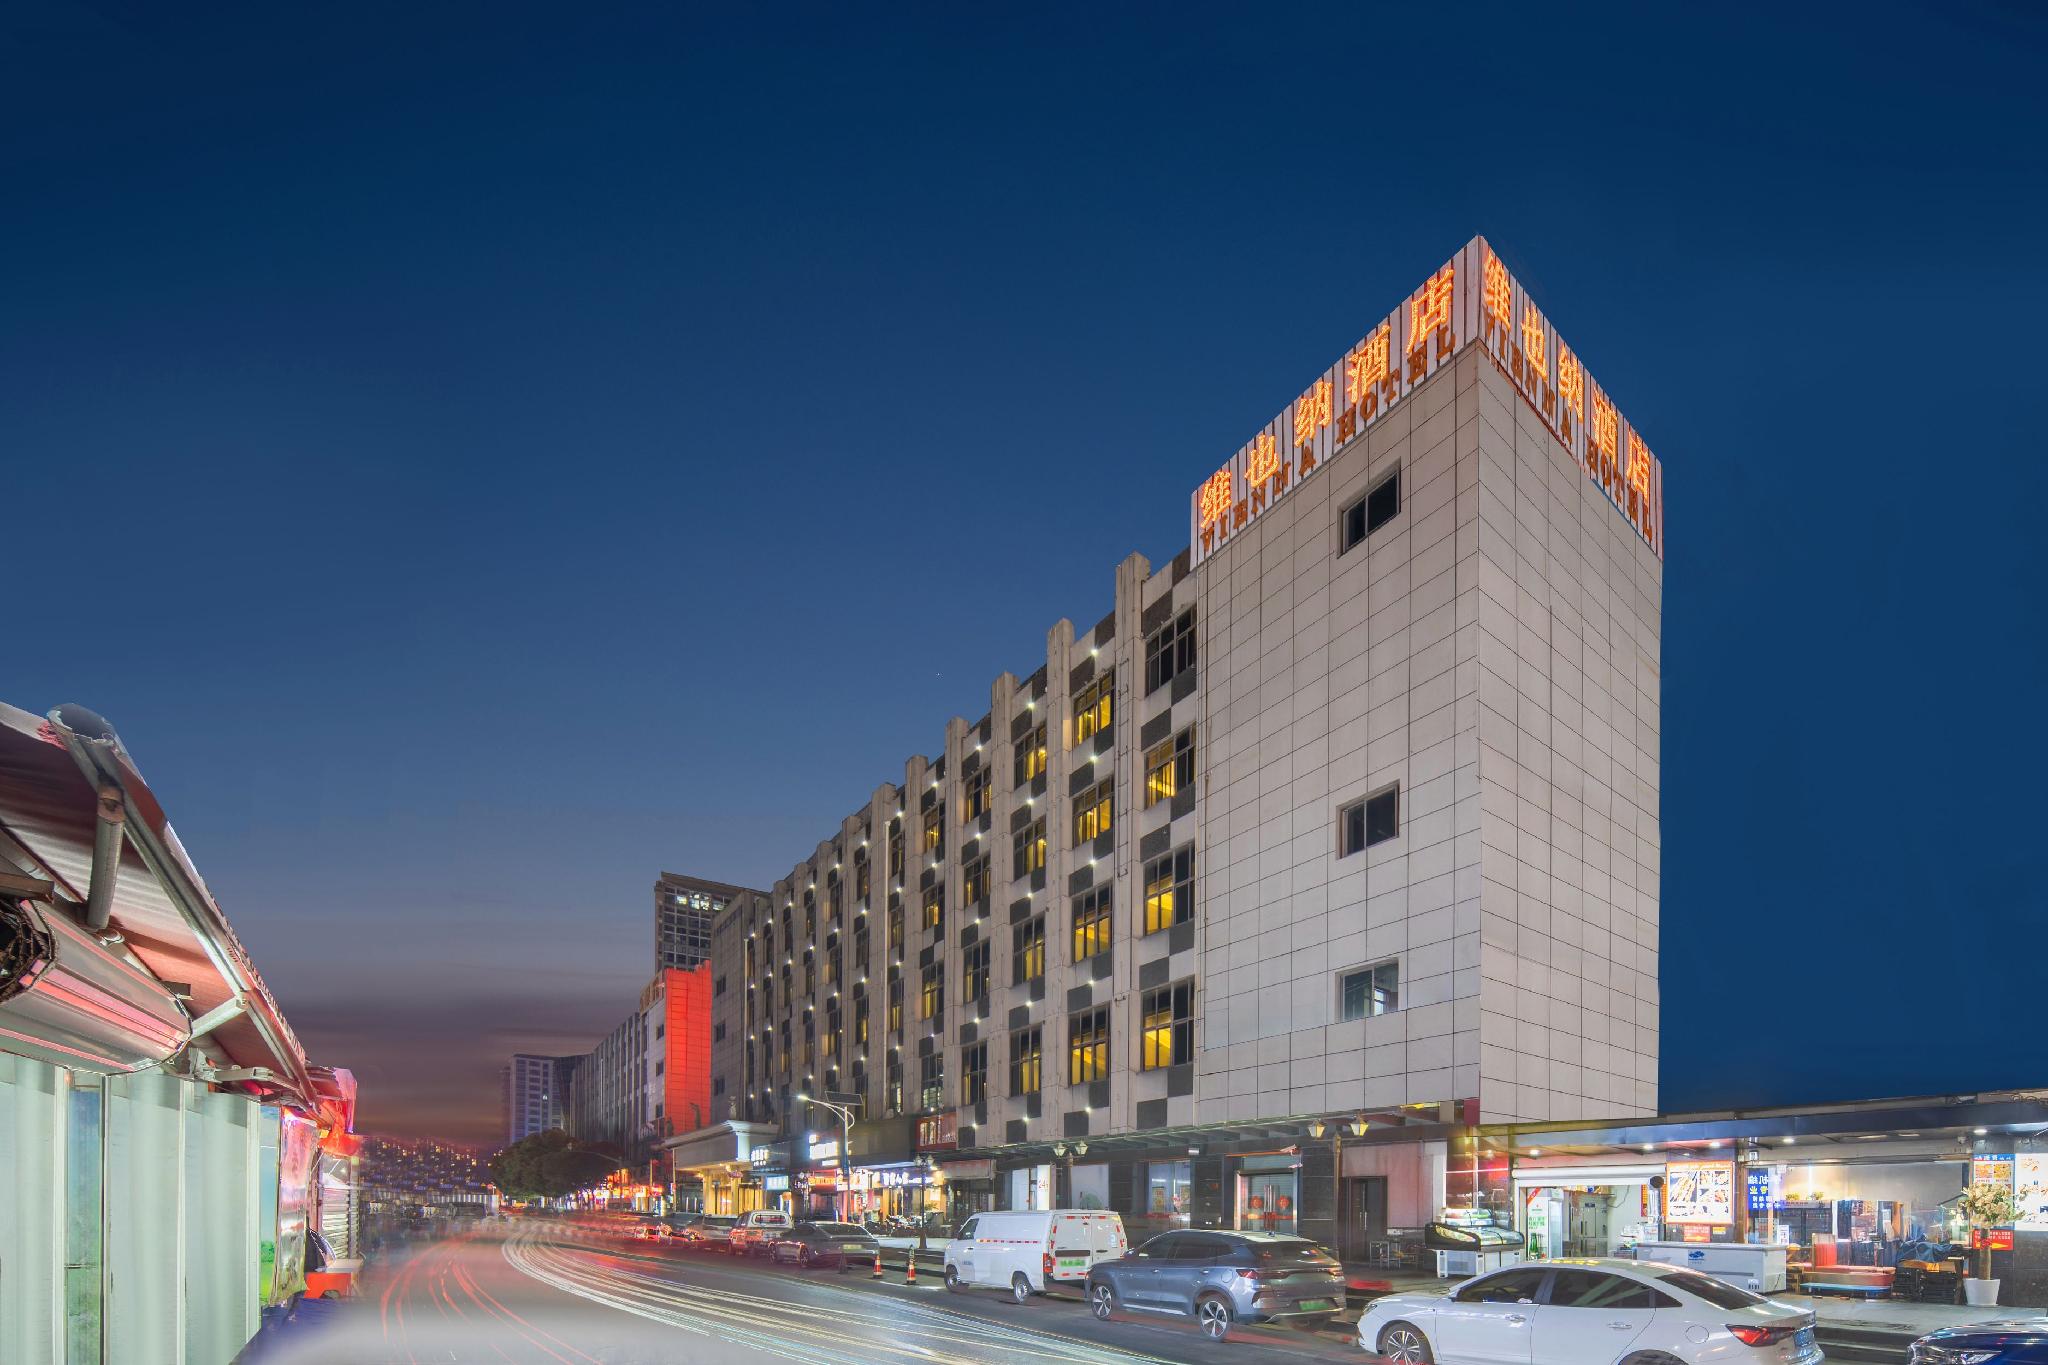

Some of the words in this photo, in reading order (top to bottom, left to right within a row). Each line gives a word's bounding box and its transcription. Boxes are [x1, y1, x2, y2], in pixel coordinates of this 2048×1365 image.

[1200, 268, 1455, 528] 维也纳酒店
[1200, 446, 1317, 551] VIENNA
[1336, 326, 1456, 444] HOTEL
